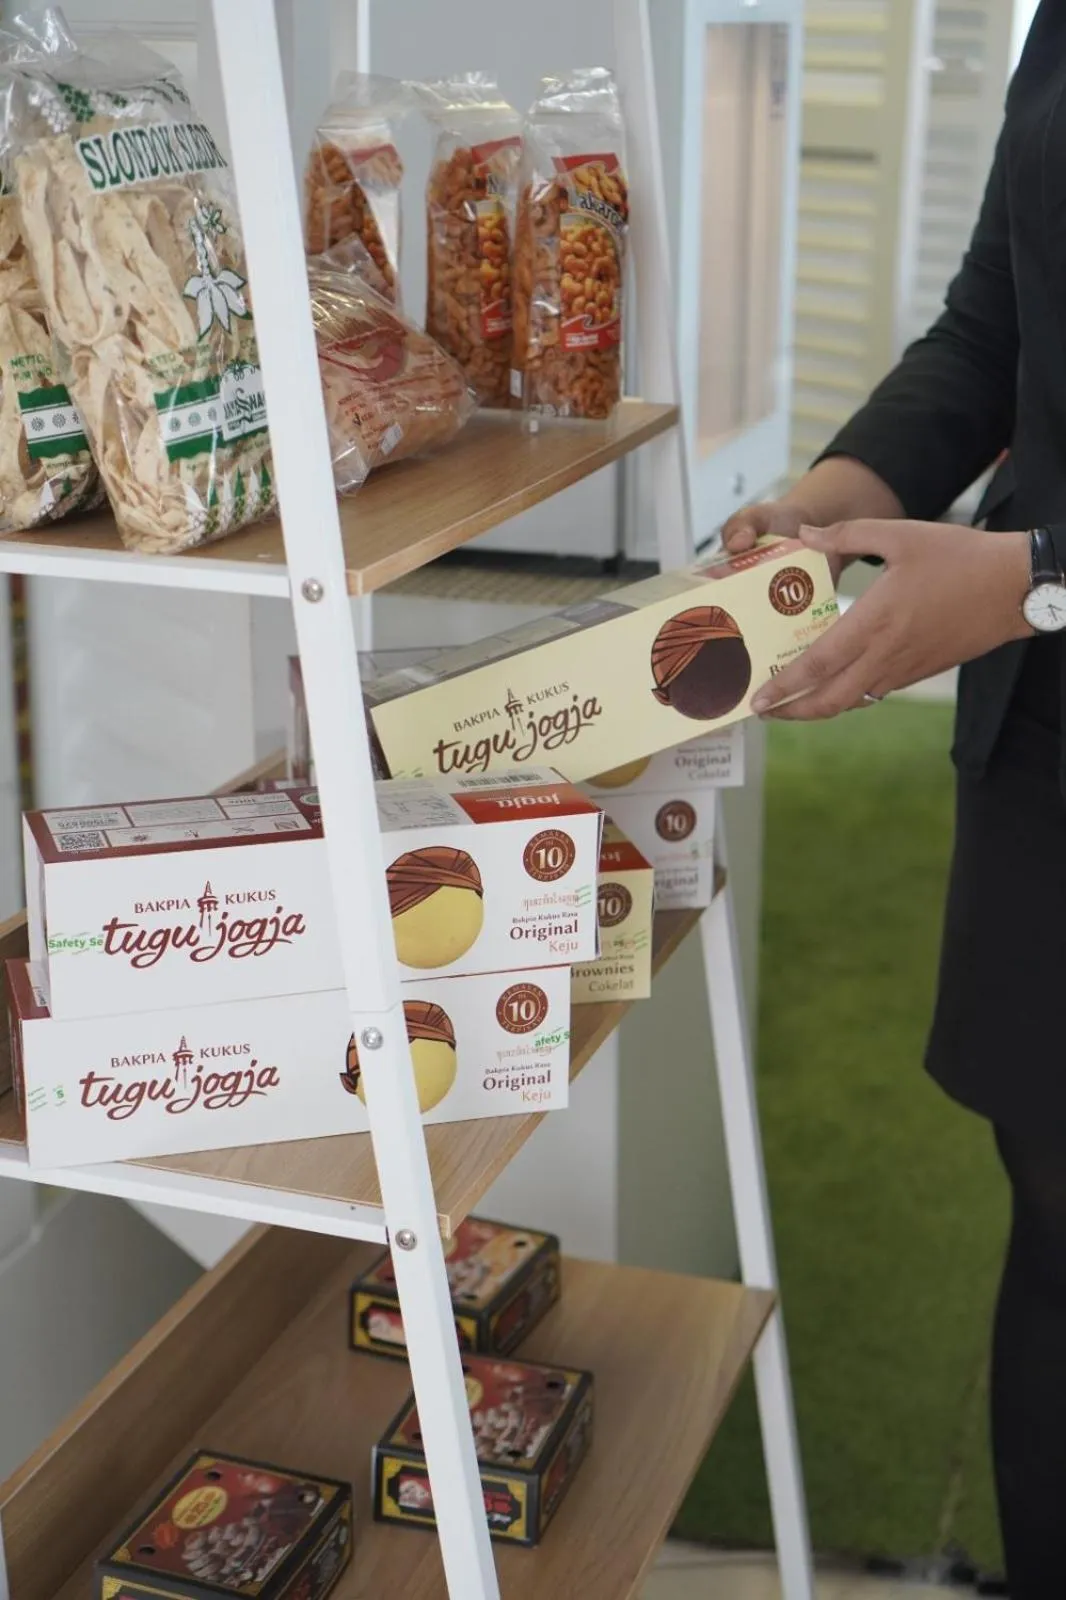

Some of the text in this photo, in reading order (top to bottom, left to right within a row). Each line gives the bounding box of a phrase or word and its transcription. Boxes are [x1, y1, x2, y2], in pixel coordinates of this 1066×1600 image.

[79, 126, 183, 189] SLONDOK
[779, 582, 805, 606] 10
[453, 681, 570, 733] BAKPIA KUKUS
[433, 694, 603, 774] tugu jogja
[674, 752, 732, 769] Original
[665, 813, 687, 832] 10
[535, 846, 563, 870] 10
[134, 889, 277, 914] BAKPIA KUKUS
[599, 896, 621, 917] 10
[103, 906, 306, 969] tugu jogja
[510, 919, 579, 941] Original
[48, 937, 86, 949] Safety
[548, 941, 579, 955] Keju
[570, 961, 635, 979] rownies
[588, 979, 634, 993] Cokelat
[508, 999, 536, 1023] 10
[111, 1043, 251, 1068] BAKPIA KUKUS
[79, 1059, 281, 1121] tugu jogja
[482, 1069, 551, 1092] Original
[522, 1090, 551, 1103] Keju
